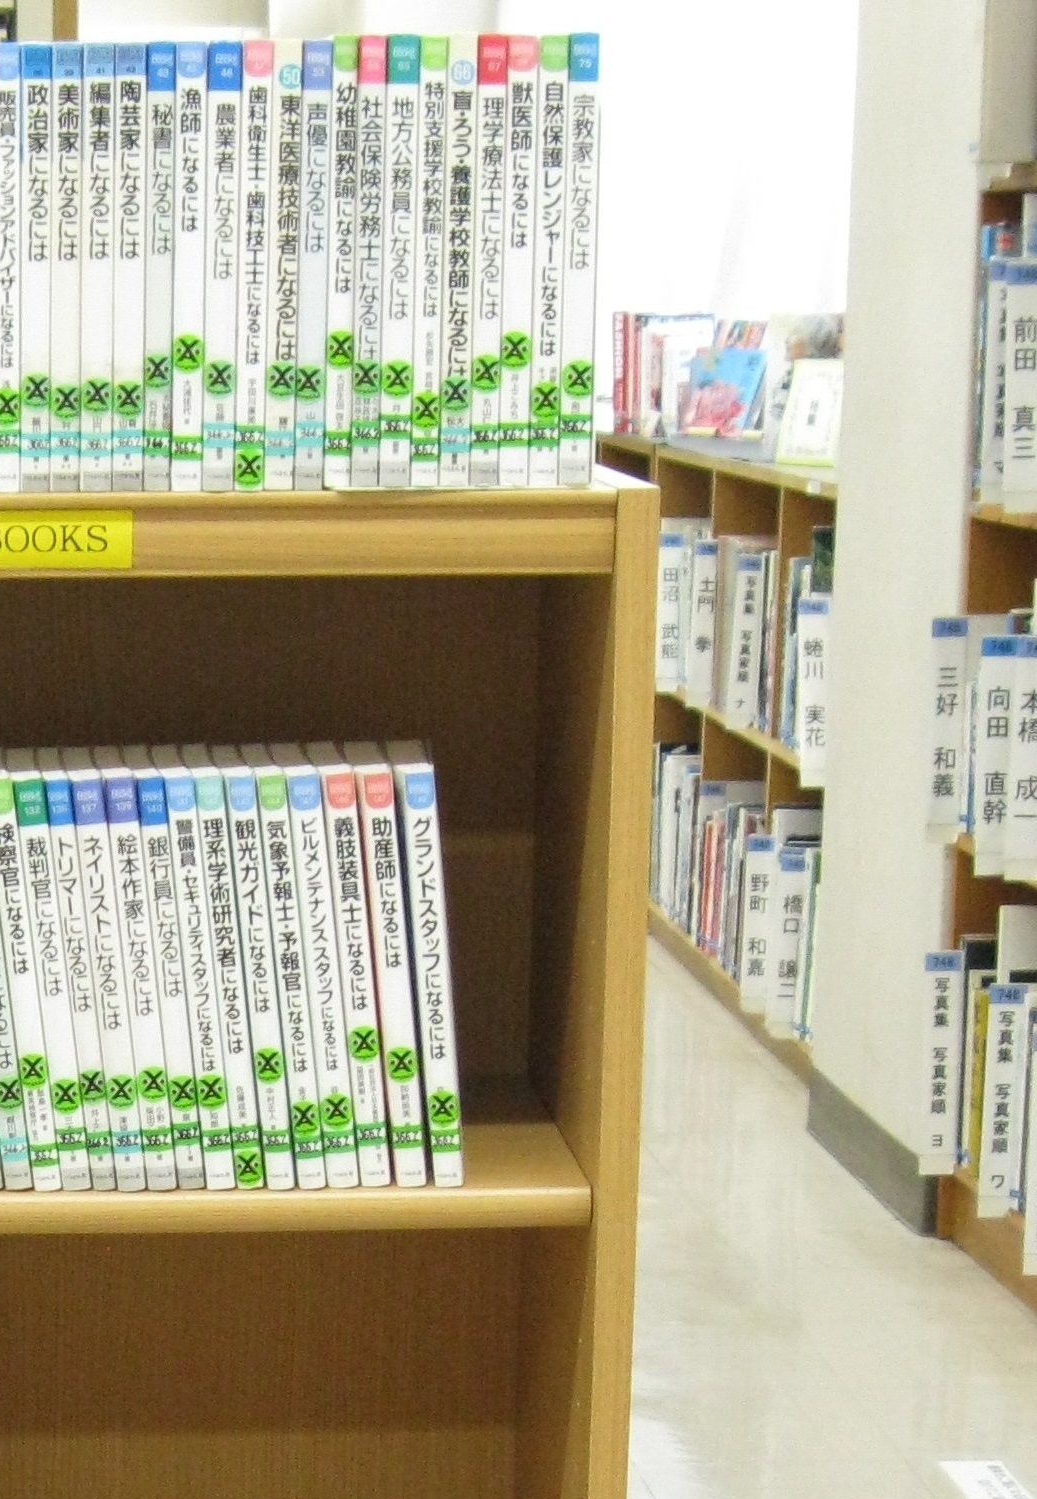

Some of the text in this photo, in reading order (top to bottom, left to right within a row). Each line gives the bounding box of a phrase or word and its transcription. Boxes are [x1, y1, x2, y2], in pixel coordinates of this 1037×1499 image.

[180, 88, 201, 232] 漁師になるには
[282, 68, 301, 86] 50
[511, 82, 532, 248] 獣医師になるには
[27, 84, 48, 261] 政治家になるには
[58, 83, 79, 260] 美術家になるには
[89, 82, 111, 260] 編集者になるには
[120, 81, 141, 260] 陶芸家になるには
[151, 104, 173, 254] 秘書になるには
[214, 104, 236, 279] 農業者になるには
[276, 95, 301, 361] 東洋医療技術者になるには
[305, 102, 327, 253] 声優になるには
[335, 83, 356, 293] 幼稚園教諭になるには
[389, 97, 414, 319] 地方公務員になるには
[480, 97, 503, 319] 理学療法士になるには
[539, 82, 563, 356] 自然保護レンジャーになるには
[570, 95, 595, 270] 宗教家になるには
[1012, 316, 1037, 459] 前田 真三
[805, 704, 826, 747] 実花
[932, 667, 959, 797] 三好 和義
[986, 686, 1010, 739] 向田
[26, 838, 63, 996] 裁判官になるには
[59, 839, 92, 1012] トリマーになるには
[84, 835, 122, 1029] ネイリストになるには
[116, 835, 153, 1016] 絵本作家になるには
[147, 838, 183, 997] 銀行員になるには
[202, 819, 243, 1054] 理系学術研究者になるには
[235, 819, 270, 1013] 観光ガイドになるには
[266, 821, 307, 1072] 気象予報士・予報官になるには
[301, 817, 338, 1071] ビルメンテナンススタッフになるには
[333, 817, 367, 1010] 義肢装具士になるには
[371, 817, 401, 967] 助産師になるには
[412, 817, 446, 1059] グランドスタッフになるには
[748, 873, 770, 914] 野町
